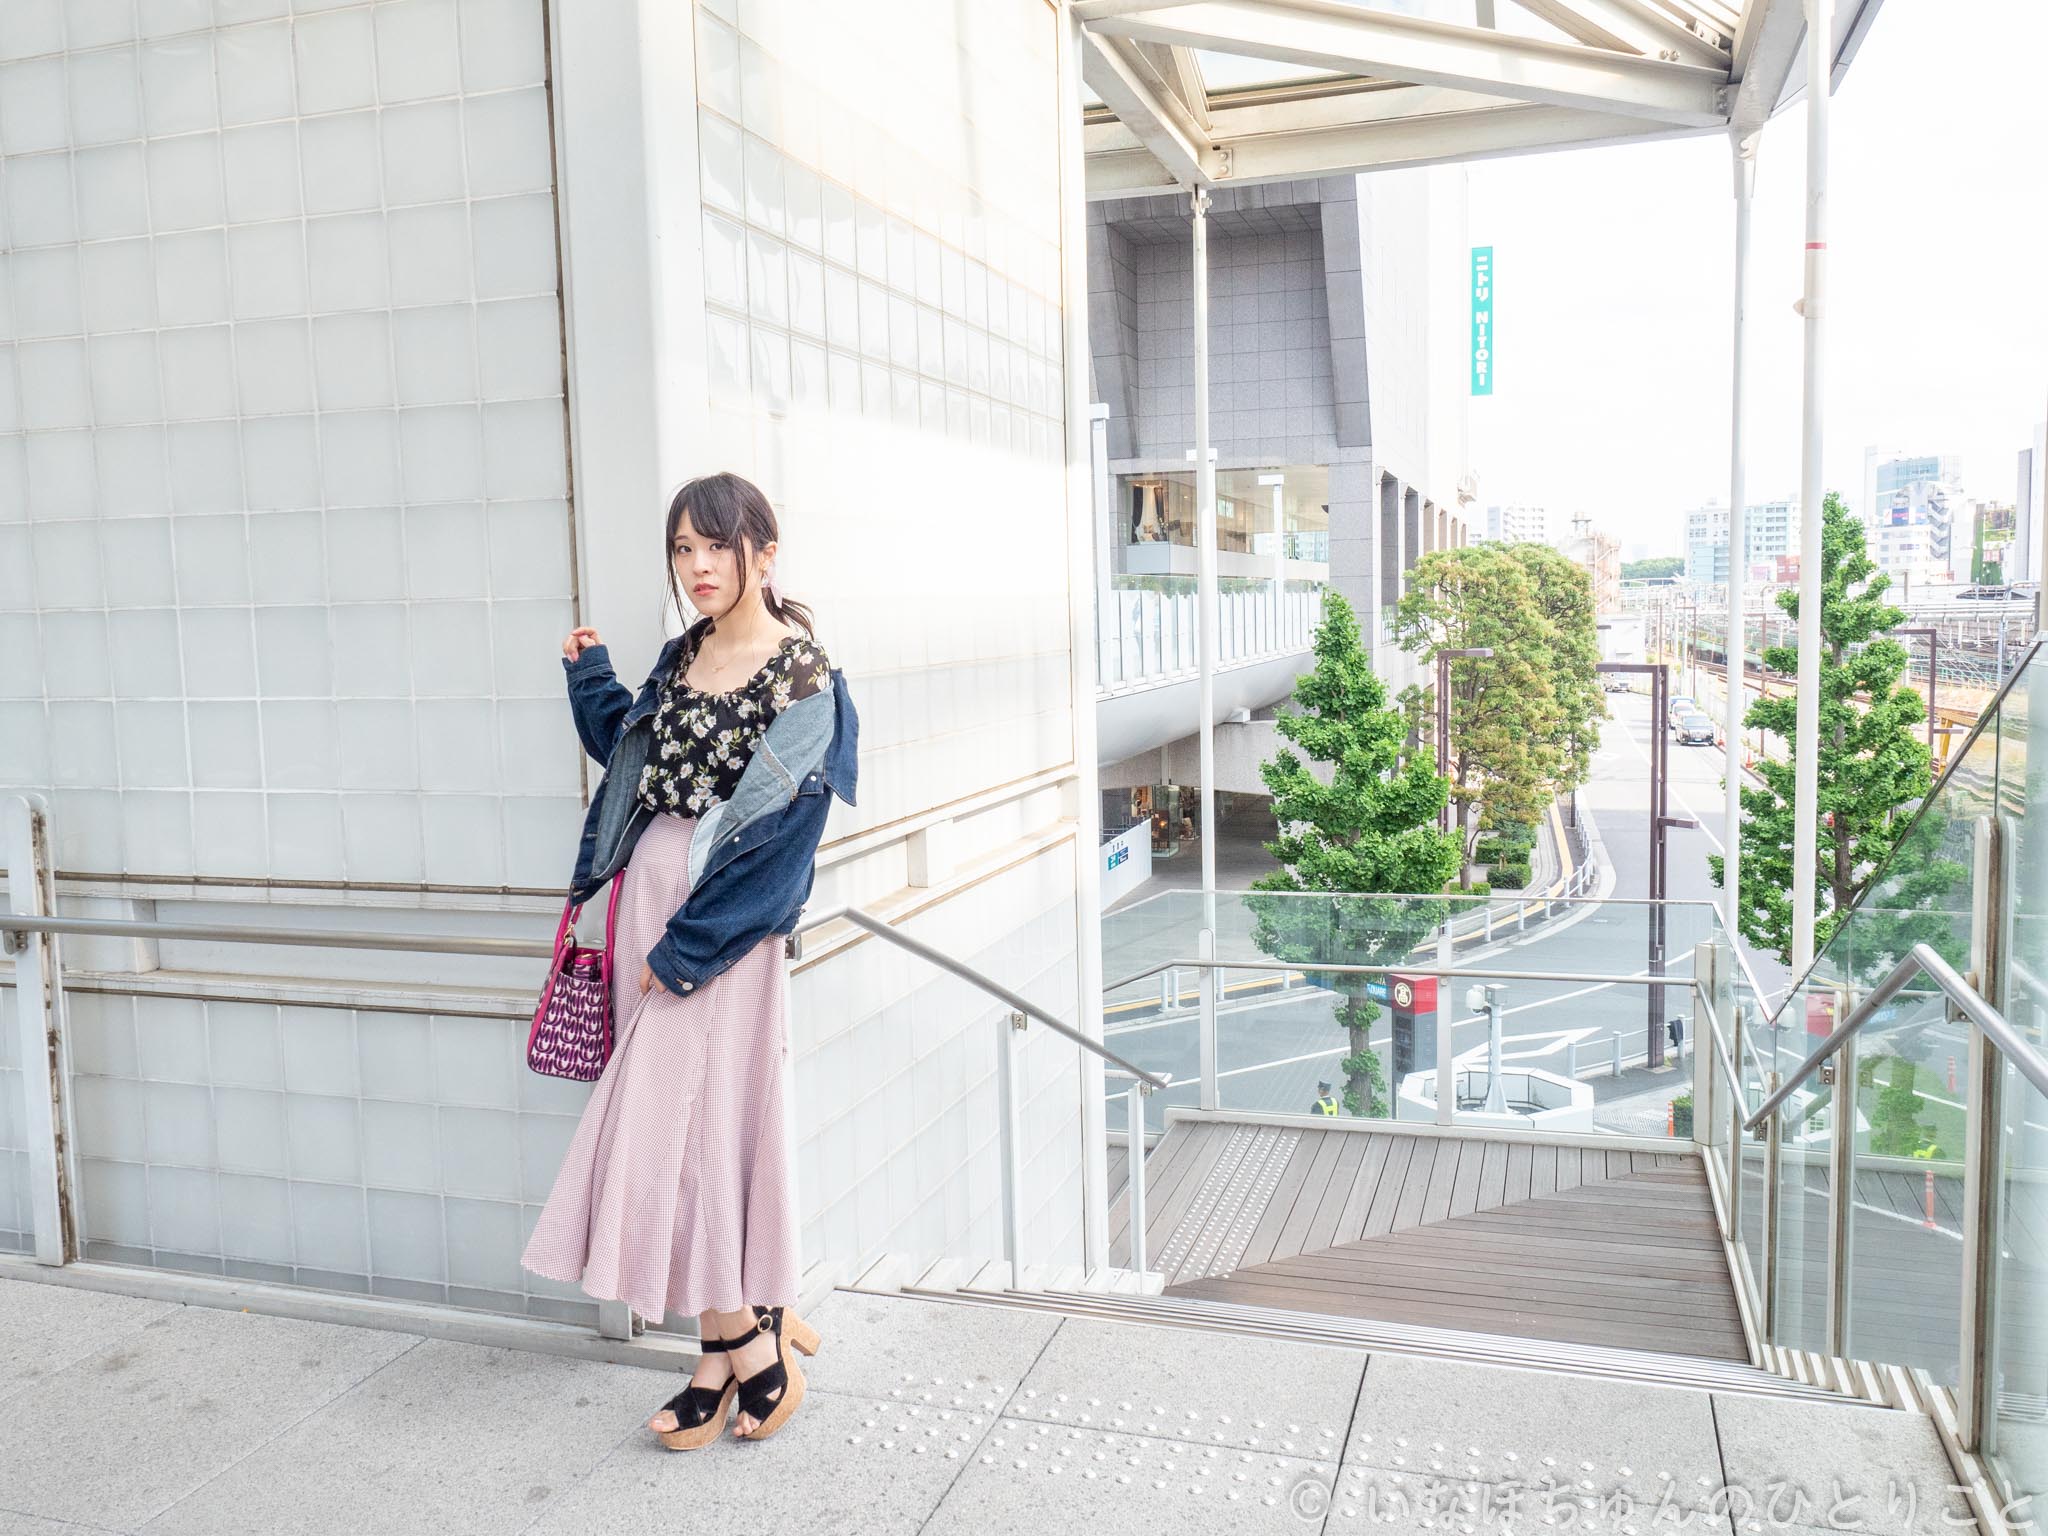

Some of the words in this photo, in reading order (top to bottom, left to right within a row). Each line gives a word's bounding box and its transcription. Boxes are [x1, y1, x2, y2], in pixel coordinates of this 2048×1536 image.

[1475, 255, 1489, 302] ニトリ
[1475, 311, 1489, 386] NITORI
